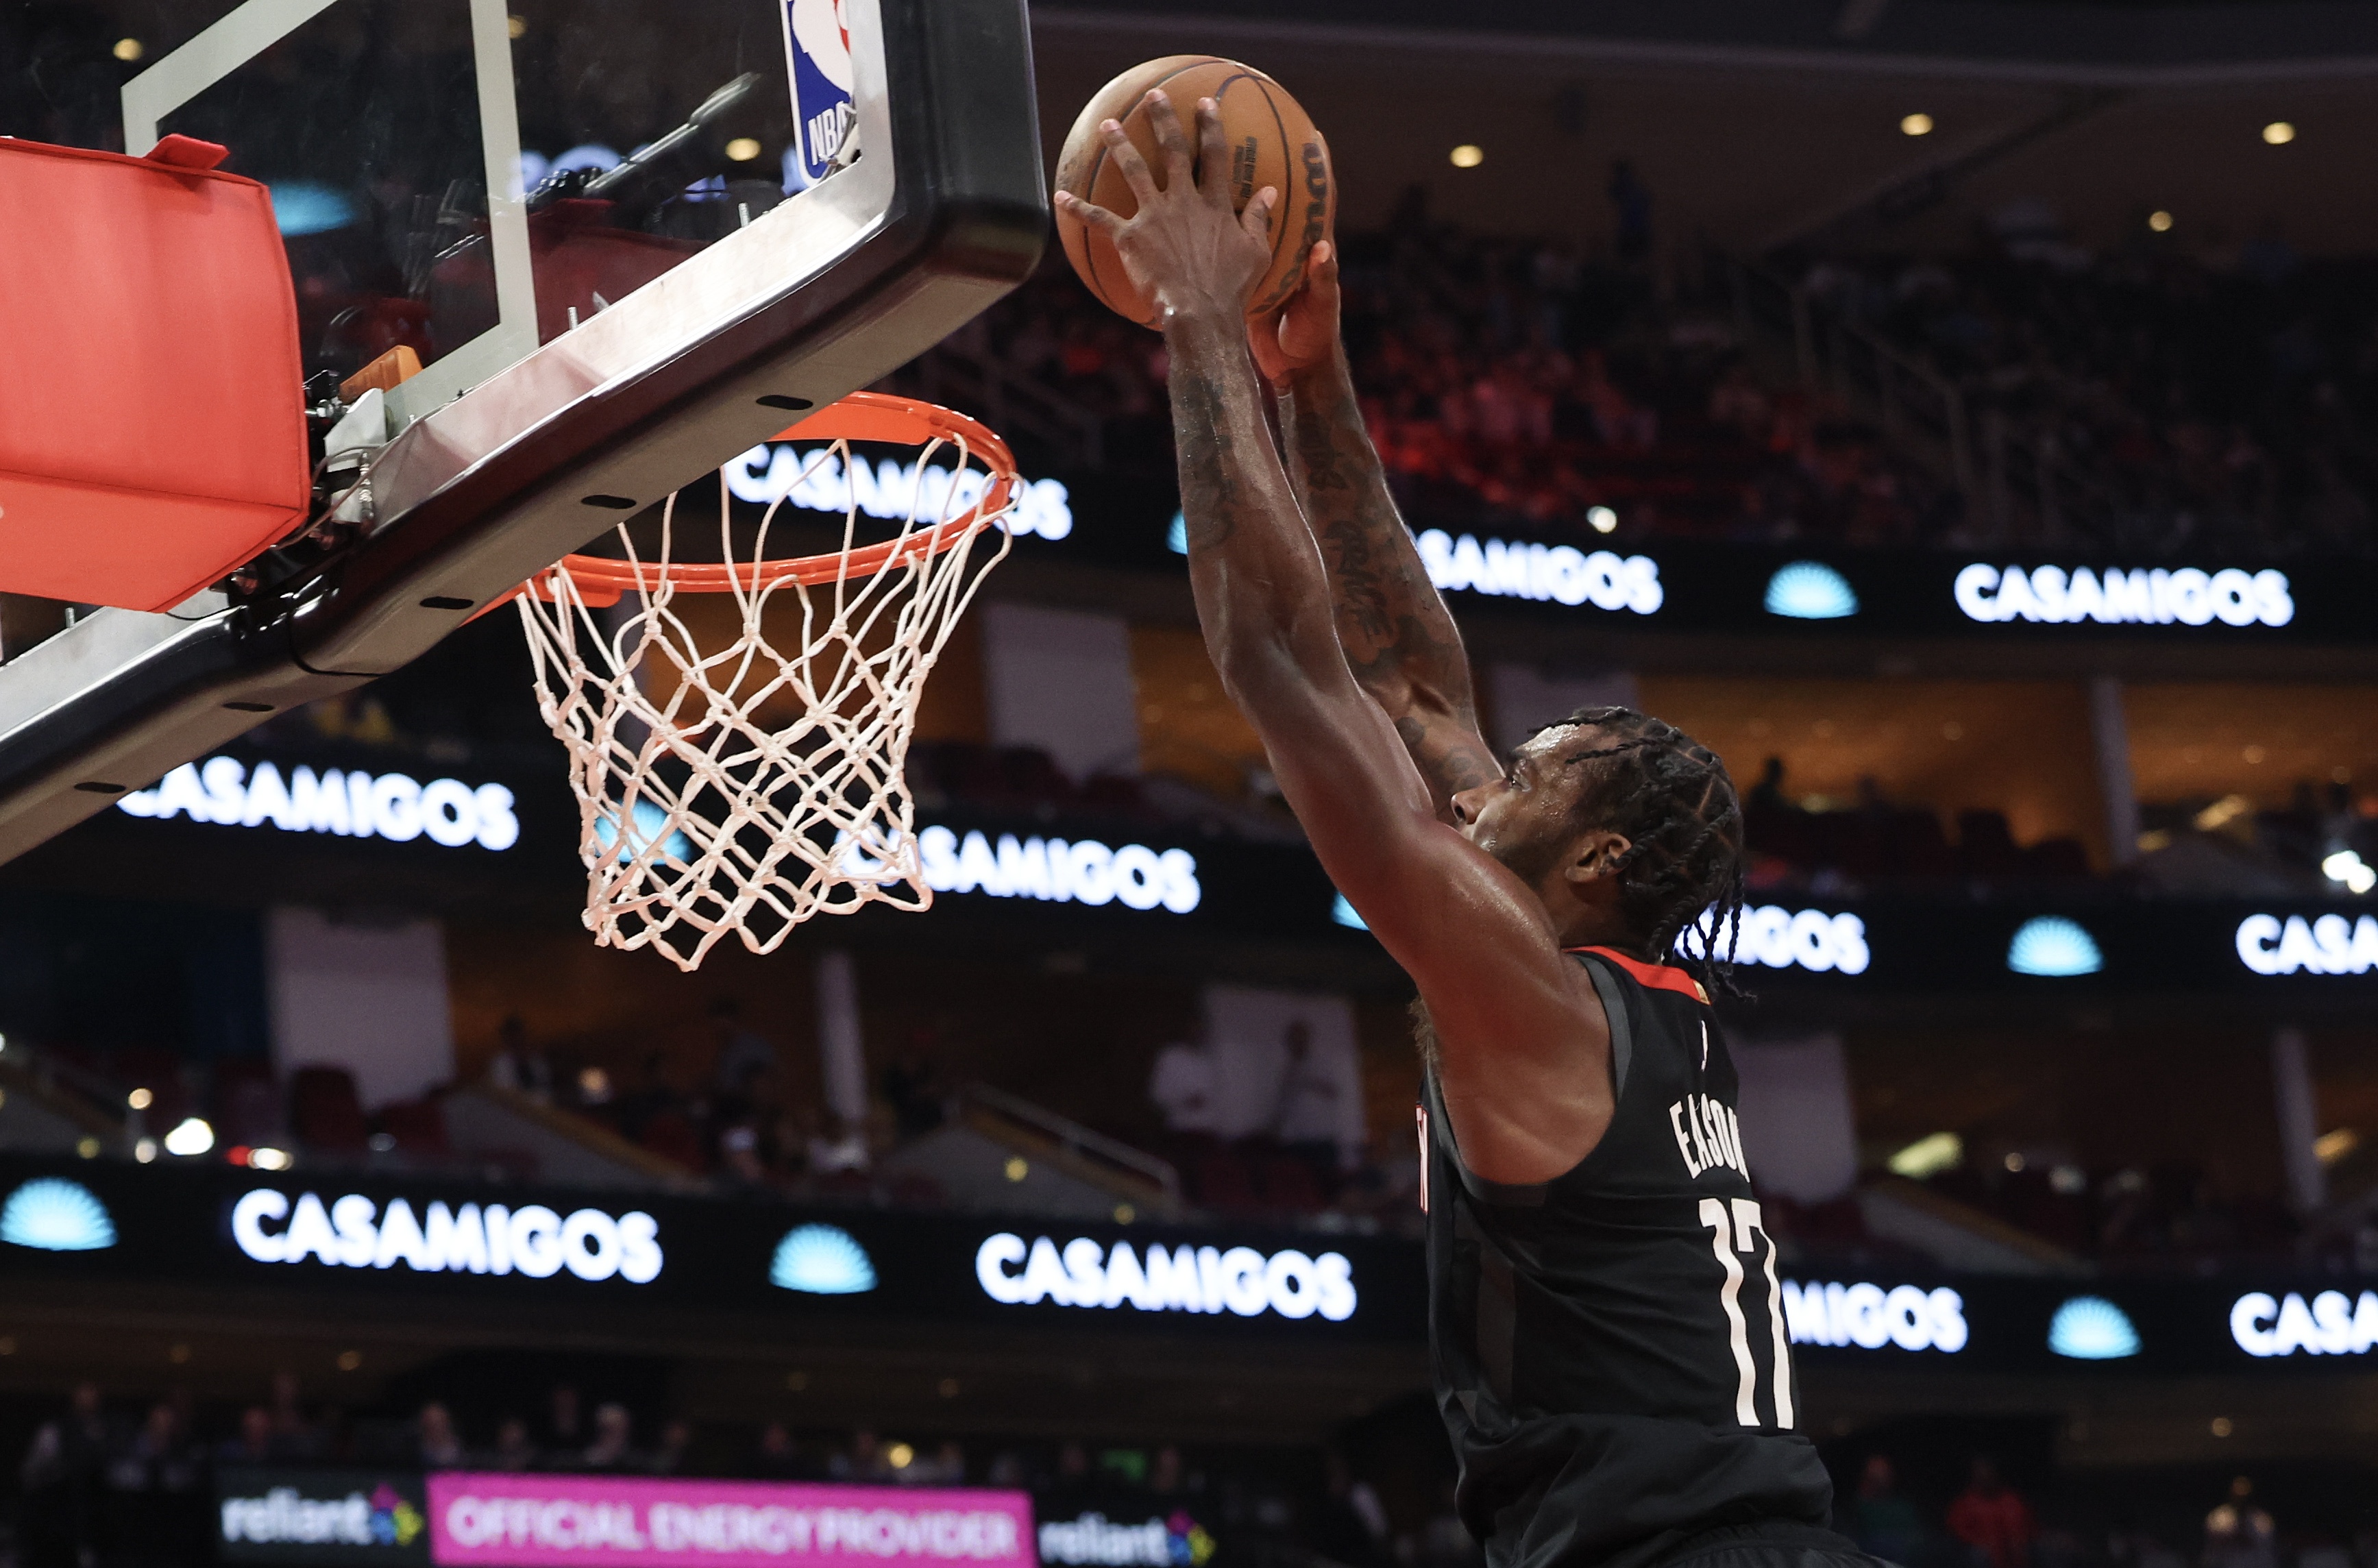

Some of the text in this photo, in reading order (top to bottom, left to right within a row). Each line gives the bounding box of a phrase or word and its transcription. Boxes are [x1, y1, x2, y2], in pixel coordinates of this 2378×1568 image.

[1410, 525, 1664, 615] SAMIGOS
[1954, 563, 2294, 627] CASAMIGOS
[1674, 903, 1870, 975] MIGOS
[2235, 914, 2378, 975] CASA
[232, 1188, 663, 1284] CASAMIGOS
[976, 1232, 1357, 1321] CASAMIGOS
[1698, 1197, 1794, 1430] 17
[2229, 1290, 2378, 1357] CASA
[447, 1497, 1016, 1559] OFFICIAL ENERGY PROVIDER
